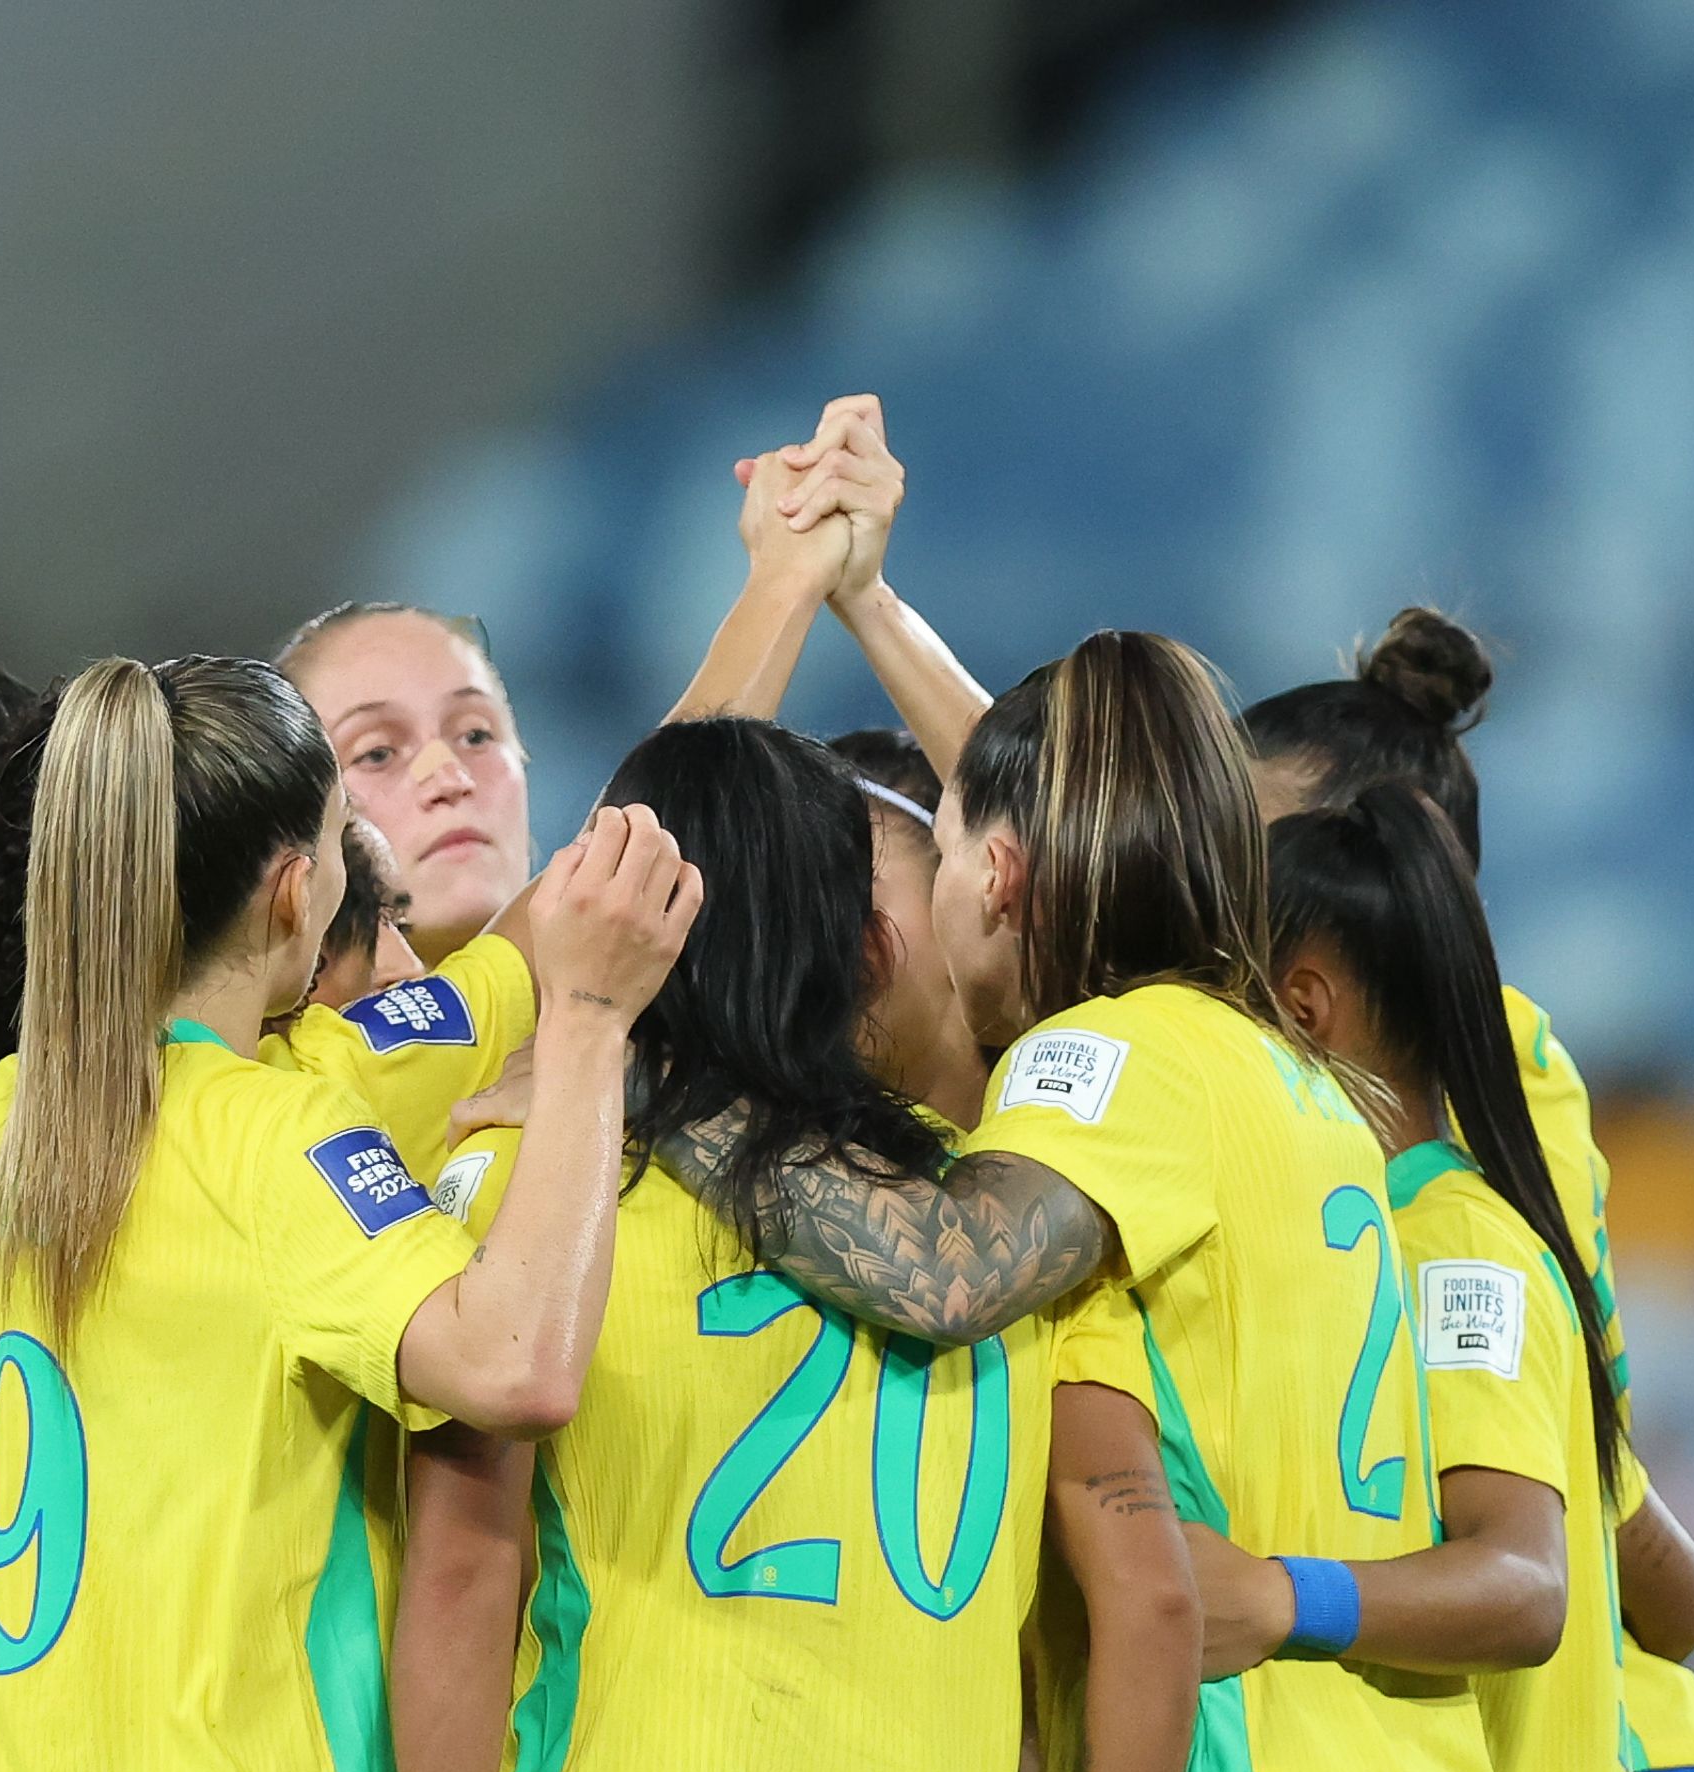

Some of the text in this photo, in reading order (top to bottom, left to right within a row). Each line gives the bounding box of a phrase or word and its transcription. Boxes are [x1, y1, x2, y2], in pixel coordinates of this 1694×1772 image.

[373, 999, 407, 1025] FIFA
[385, 989, 431, 1031] SERIE
[413, 986, 446, 1021] 2026
[1036, 1040, 1099, 1058] FOOTBALL
[1033, 1050, 1097, 1072] UNITES
[1040, 1080, 1069, 1092] FIFA
[1050, 1065, 1096, 1088] World
[346, 1148, 395, 1171] FIFA
[1443, 1278, 1504, 1295] FOOTBALL
[1443, 1293, 1505, 1317] UNITES
[1466, 1313, 1506, 1338] World
[1459, 1335, 1488, 1348] FIFA
[685, 1269, 1010, 1622] 20
